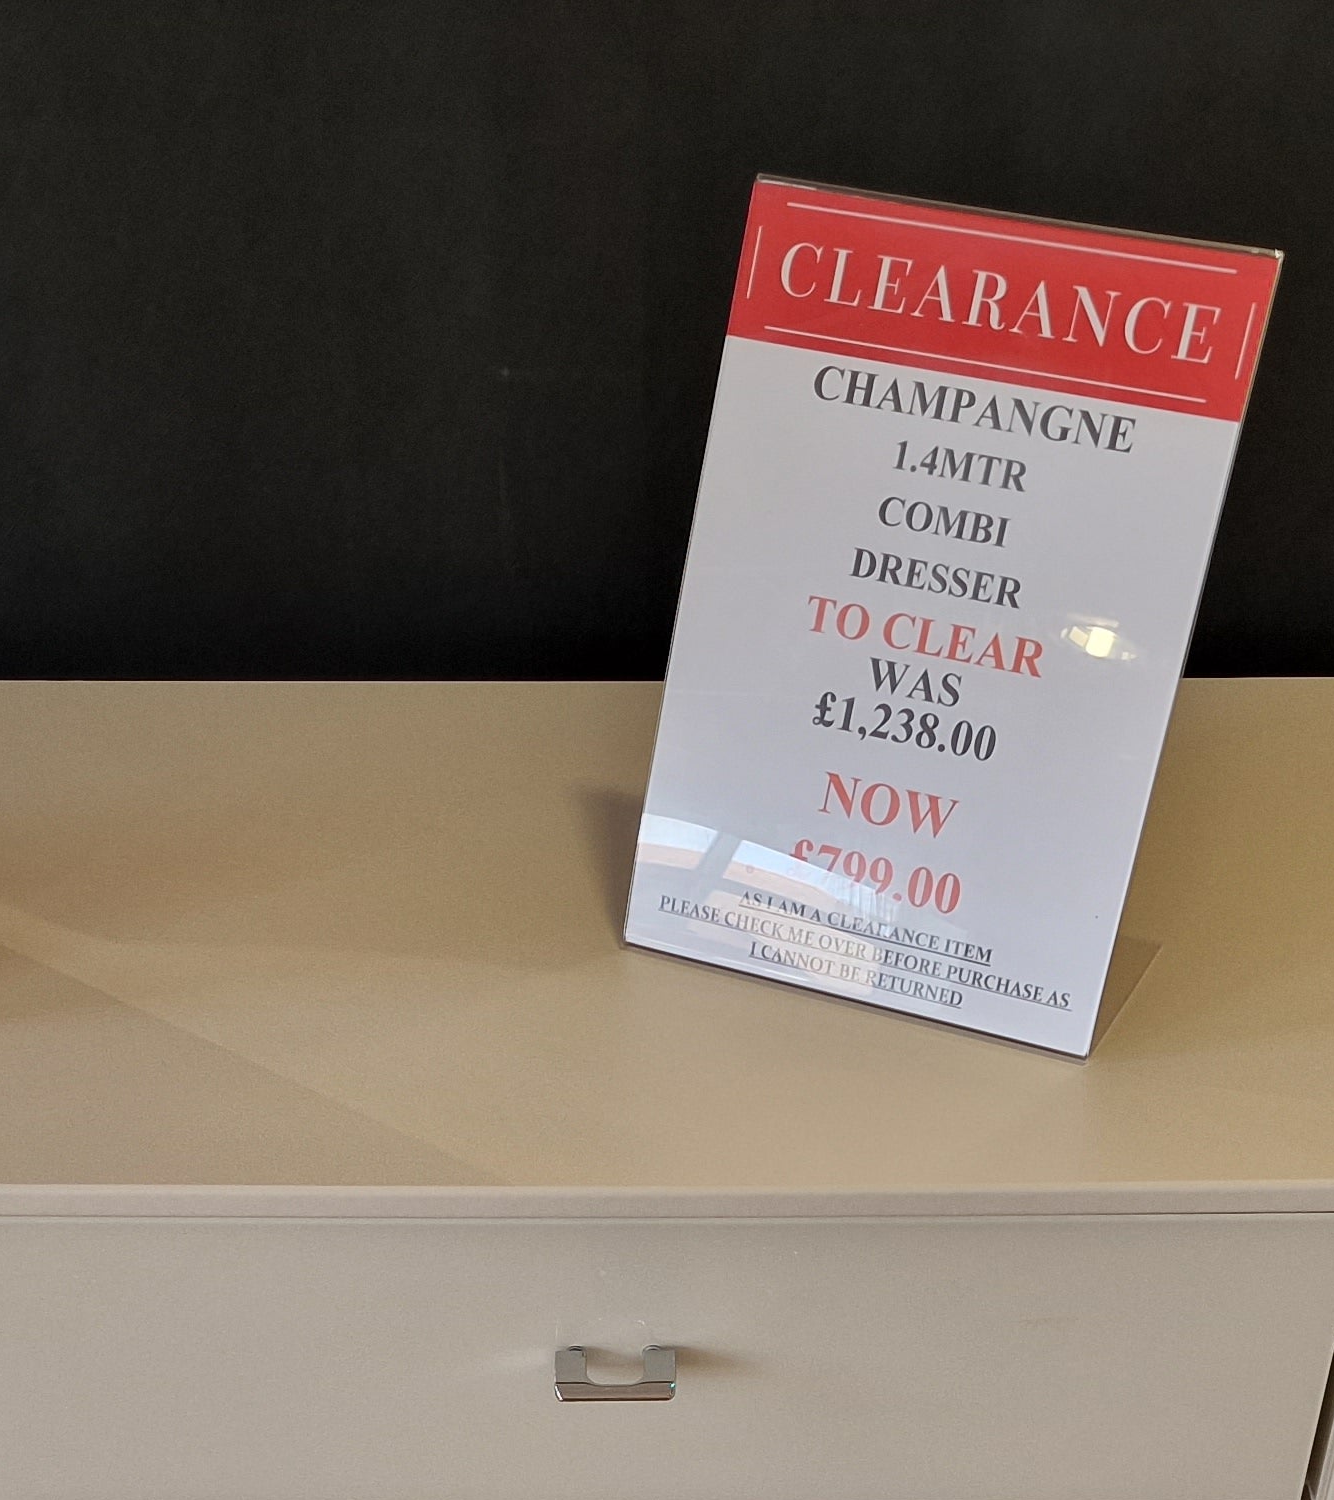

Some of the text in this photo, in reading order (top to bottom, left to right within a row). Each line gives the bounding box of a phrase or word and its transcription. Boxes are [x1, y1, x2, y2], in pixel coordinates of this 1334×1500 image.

[780, 242, 1221, 364] CLEARANCE
[814, 365, 1136, 453] CHAMPANGNE
[893, 440, 1026, 492] 1.4MTR
[878, 496, 1011, 548] COMBI
[850, 547, 1021, 609] DRESSER
[808, 595, 1043, 678] TO CLEAR
[870, 657, 962, 707] WAS
[812, 692, 996, 761] £1,238.00
[819, 771, 959, 838] NOW
[789, 839, 961, 914] £799.00
[660, 894, 1071, 1008] PLEASE CHECK ME OVER BEFORE PURCHASE AS
[739, 891, 762, 907] AS
[767, 896, 773, 909] I
[775, 901, 805, 917] AM
[809, 908, 823, 922] A
[944, 939, 993, 963] ITEM
[750, 941, 963, 1006] I CANNOT BE RETURNED
